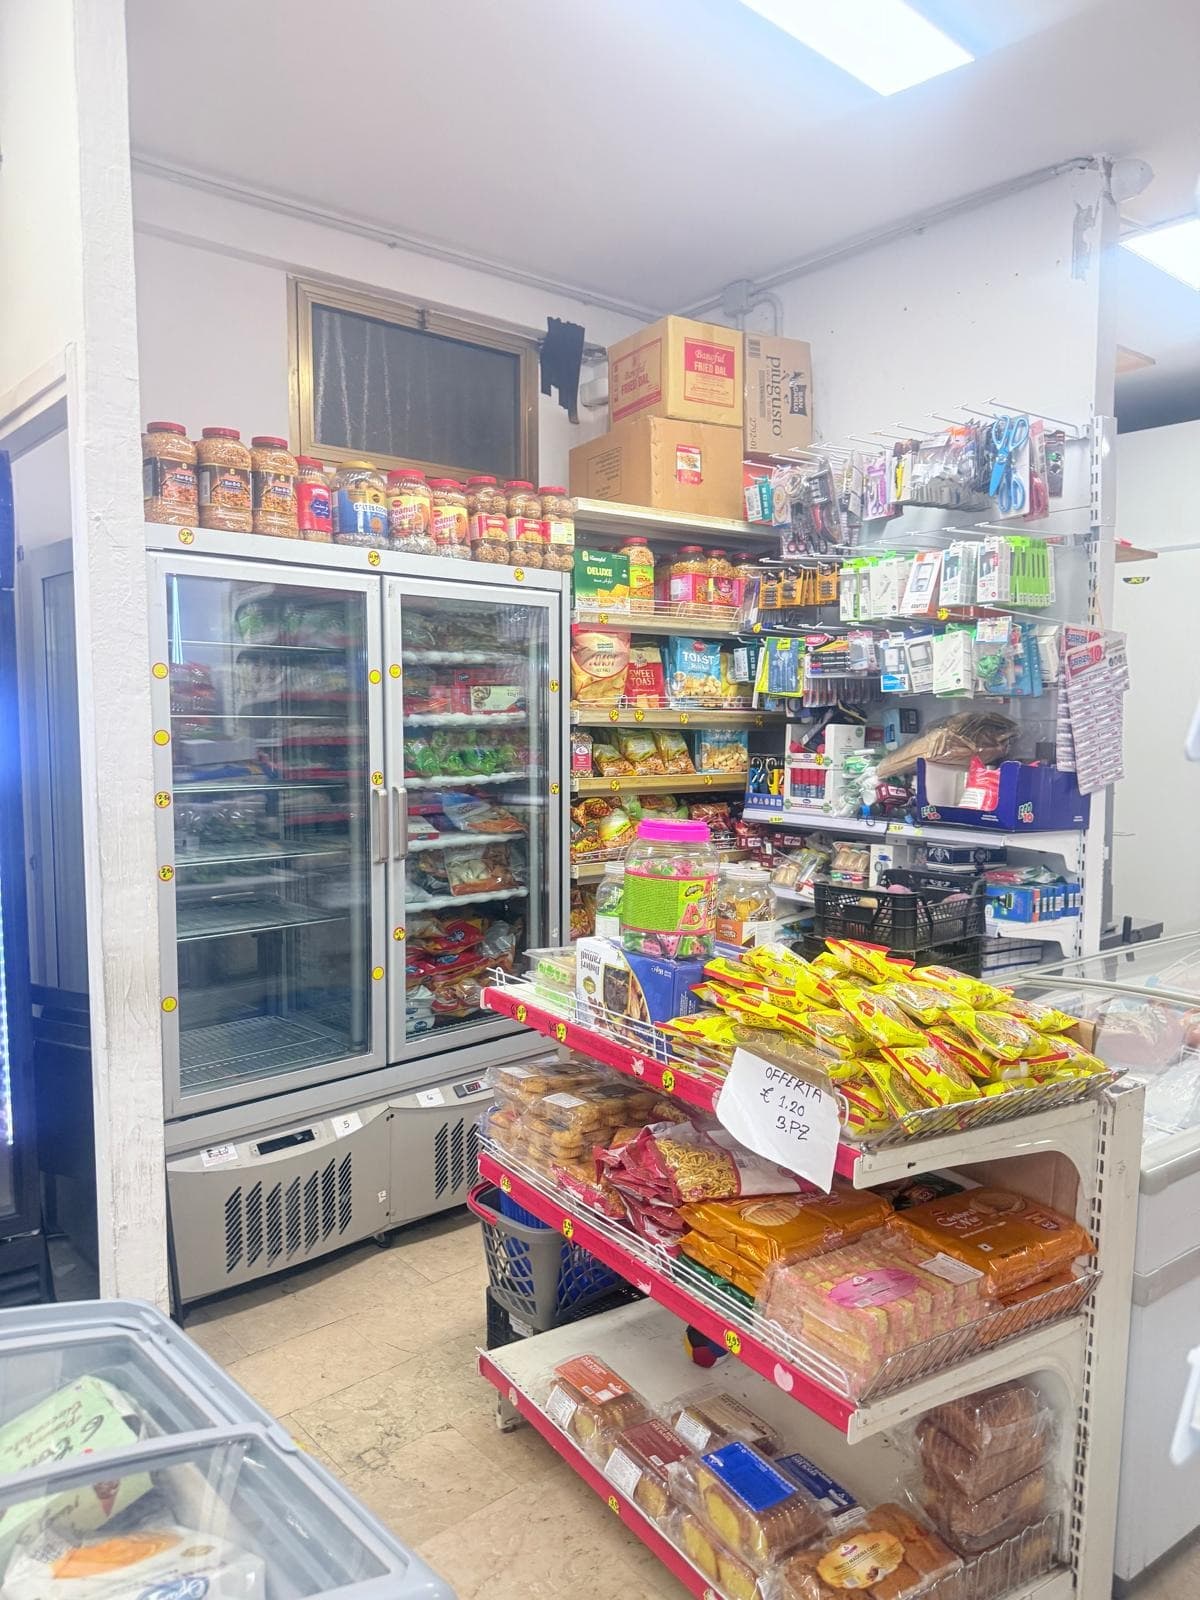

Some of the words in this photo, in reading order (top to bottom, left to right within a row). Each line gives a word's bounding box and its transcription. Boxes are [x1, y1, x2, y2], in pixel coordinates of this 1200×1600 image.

[682, 651, 715, 665] TOAST
[631, 677, 655, 686] TOAST
[765, 1066, 822, 1103] OFFERTA
[760, 1087, 774, 1103] €
[778, 1096, 805, 1117] 1.20
[343, 1120, 350, 1129] 5
